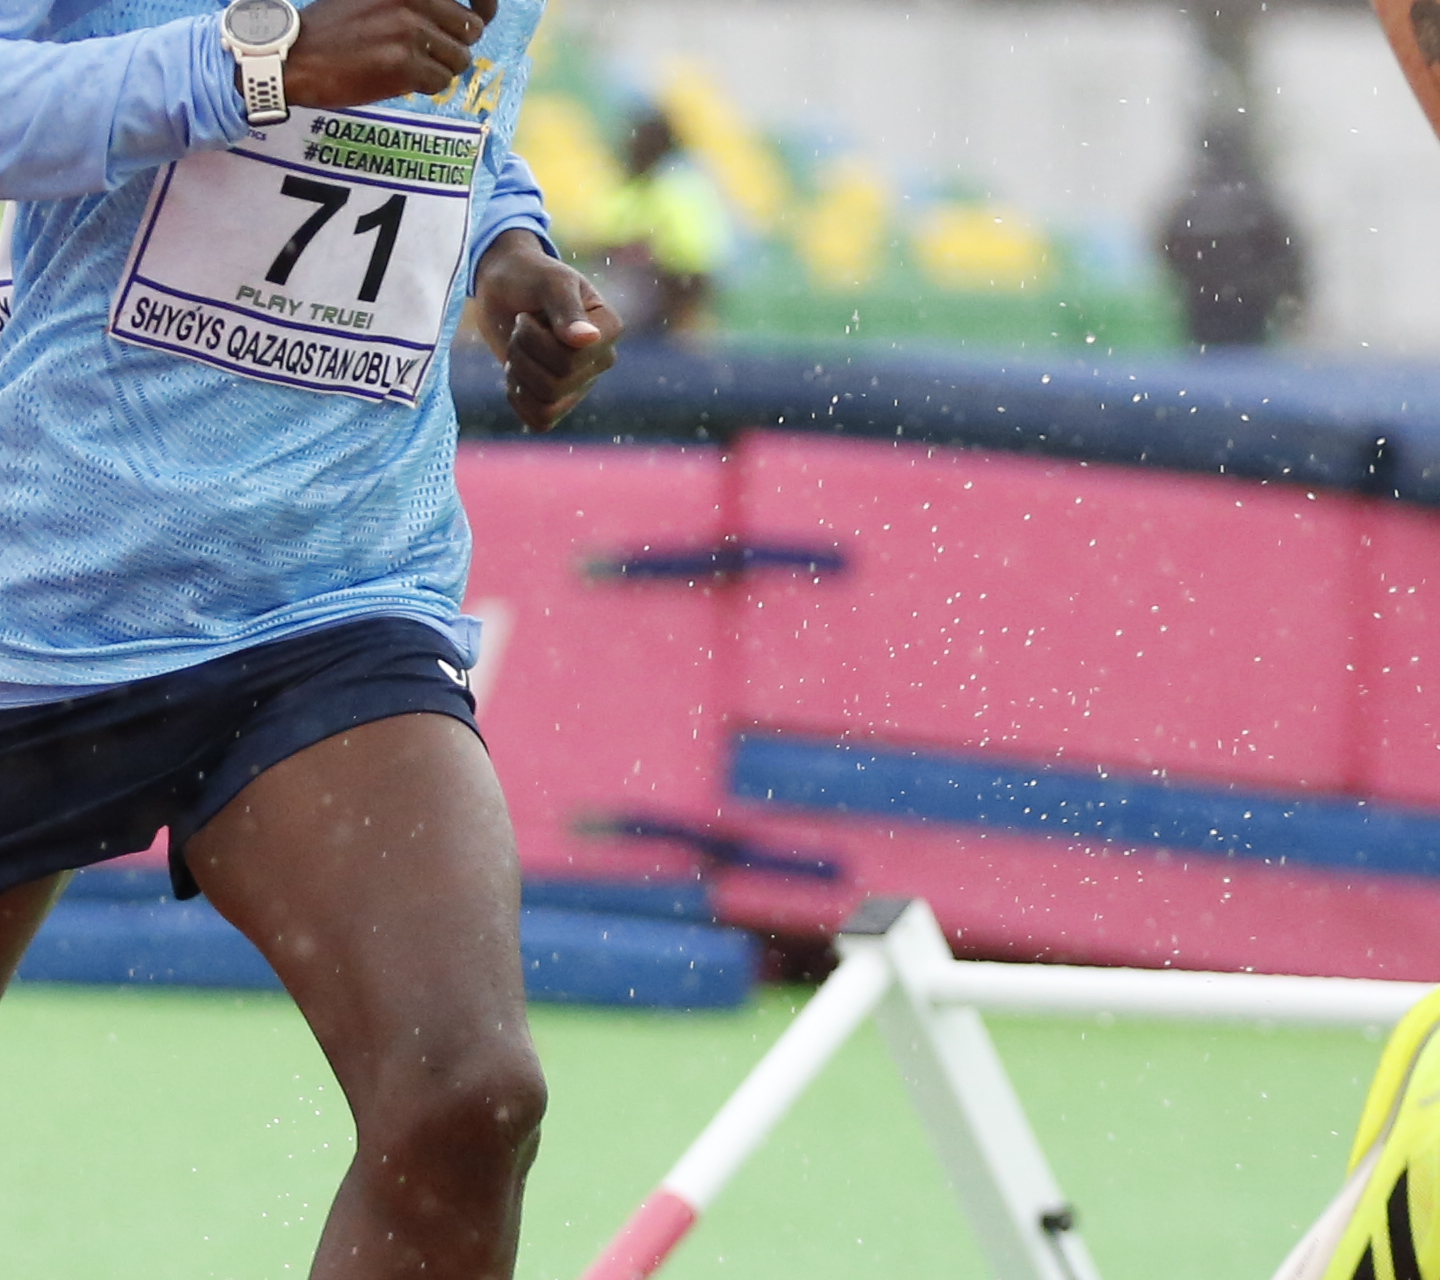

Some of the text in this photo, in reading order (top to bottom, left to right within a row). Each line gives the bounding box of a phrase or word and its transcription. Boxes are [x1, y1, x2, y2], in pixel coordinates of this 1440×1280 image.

[310, 115, 473, 158] #QAZAQATHLETICS
[304, 141, 465, 185] #CLEANATHLETICS
[265, 175, 408, 303] 71
[235, 285, 375, 330] PLAY TRUE!
[227, 325, 356, 380] QAZAQSTAN
